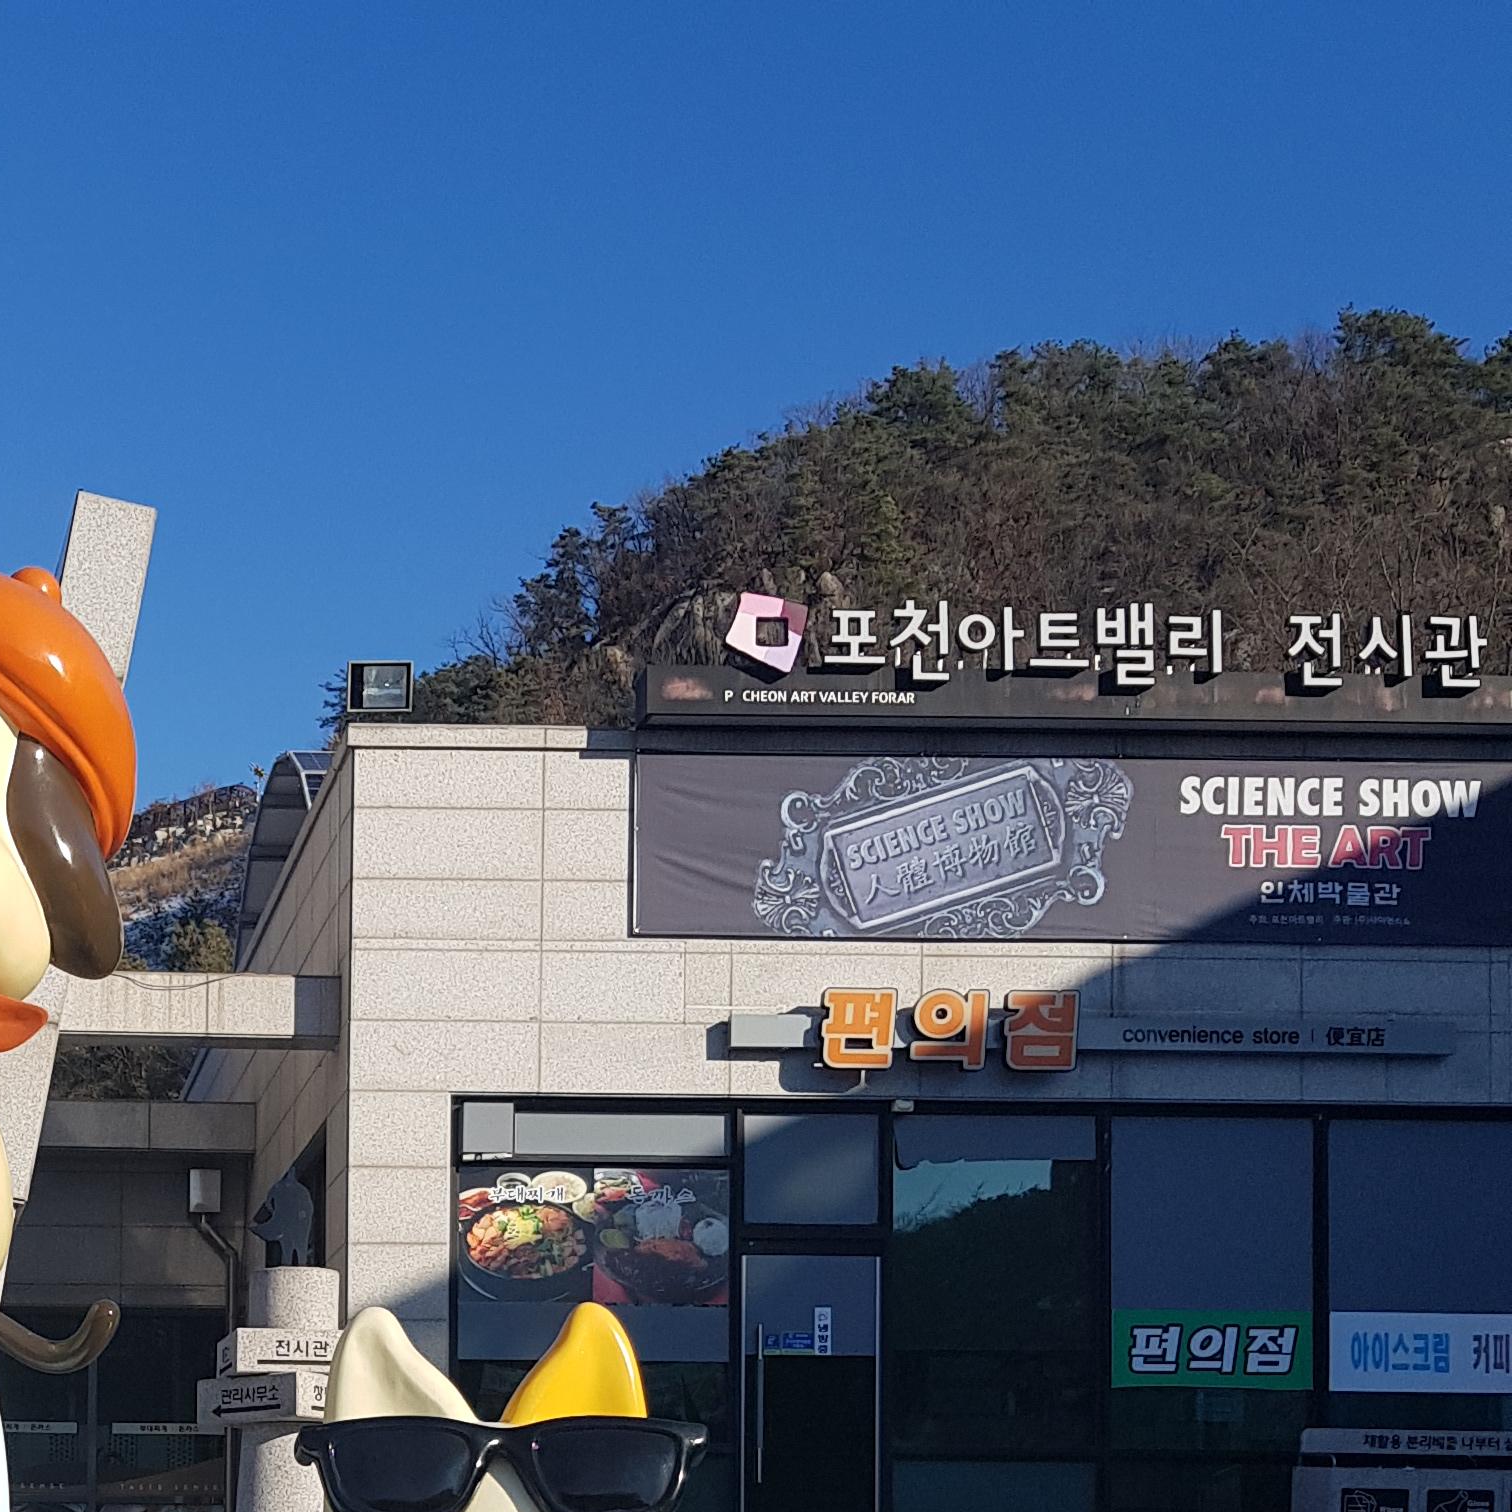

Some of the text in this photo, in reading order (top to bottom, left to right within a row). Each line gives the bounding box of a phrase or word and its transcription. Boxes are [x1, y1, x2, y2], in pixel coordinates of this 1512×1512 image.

[823, 599, 1489, 688] 포천아트밸리 전시관
[790, 690, 817, 704] ART
[819, 691, 868, 705] VALLEY
[871, 691, 916, 705] FORAR
[1180, 775, 1482, 819] SCIENCE SHOW
[846, 788, 1027, 870] SCIENCE SHOW
[1221, 824, 1432, 870] THE ART
[864, 821, 1037, 906] 人體博物館
[1260, 879, 1402, 907] 인체박물관
[821, 987, 1081, 1071] 편의점
[1122, 1025, 1300, 1045] convenience store
[1325, 1025, 1386, 1047] 便宜店
[488, 1184, 568, 1204] 부대찌개
[275, 1340, 330, 1358] 전시관
[1129, 1323, 1299, 1375] 편의점
[1350, 1331, 1511, 1375] 아이스크림 커피
[220, 1385, 280, 1405] 관리사무소
